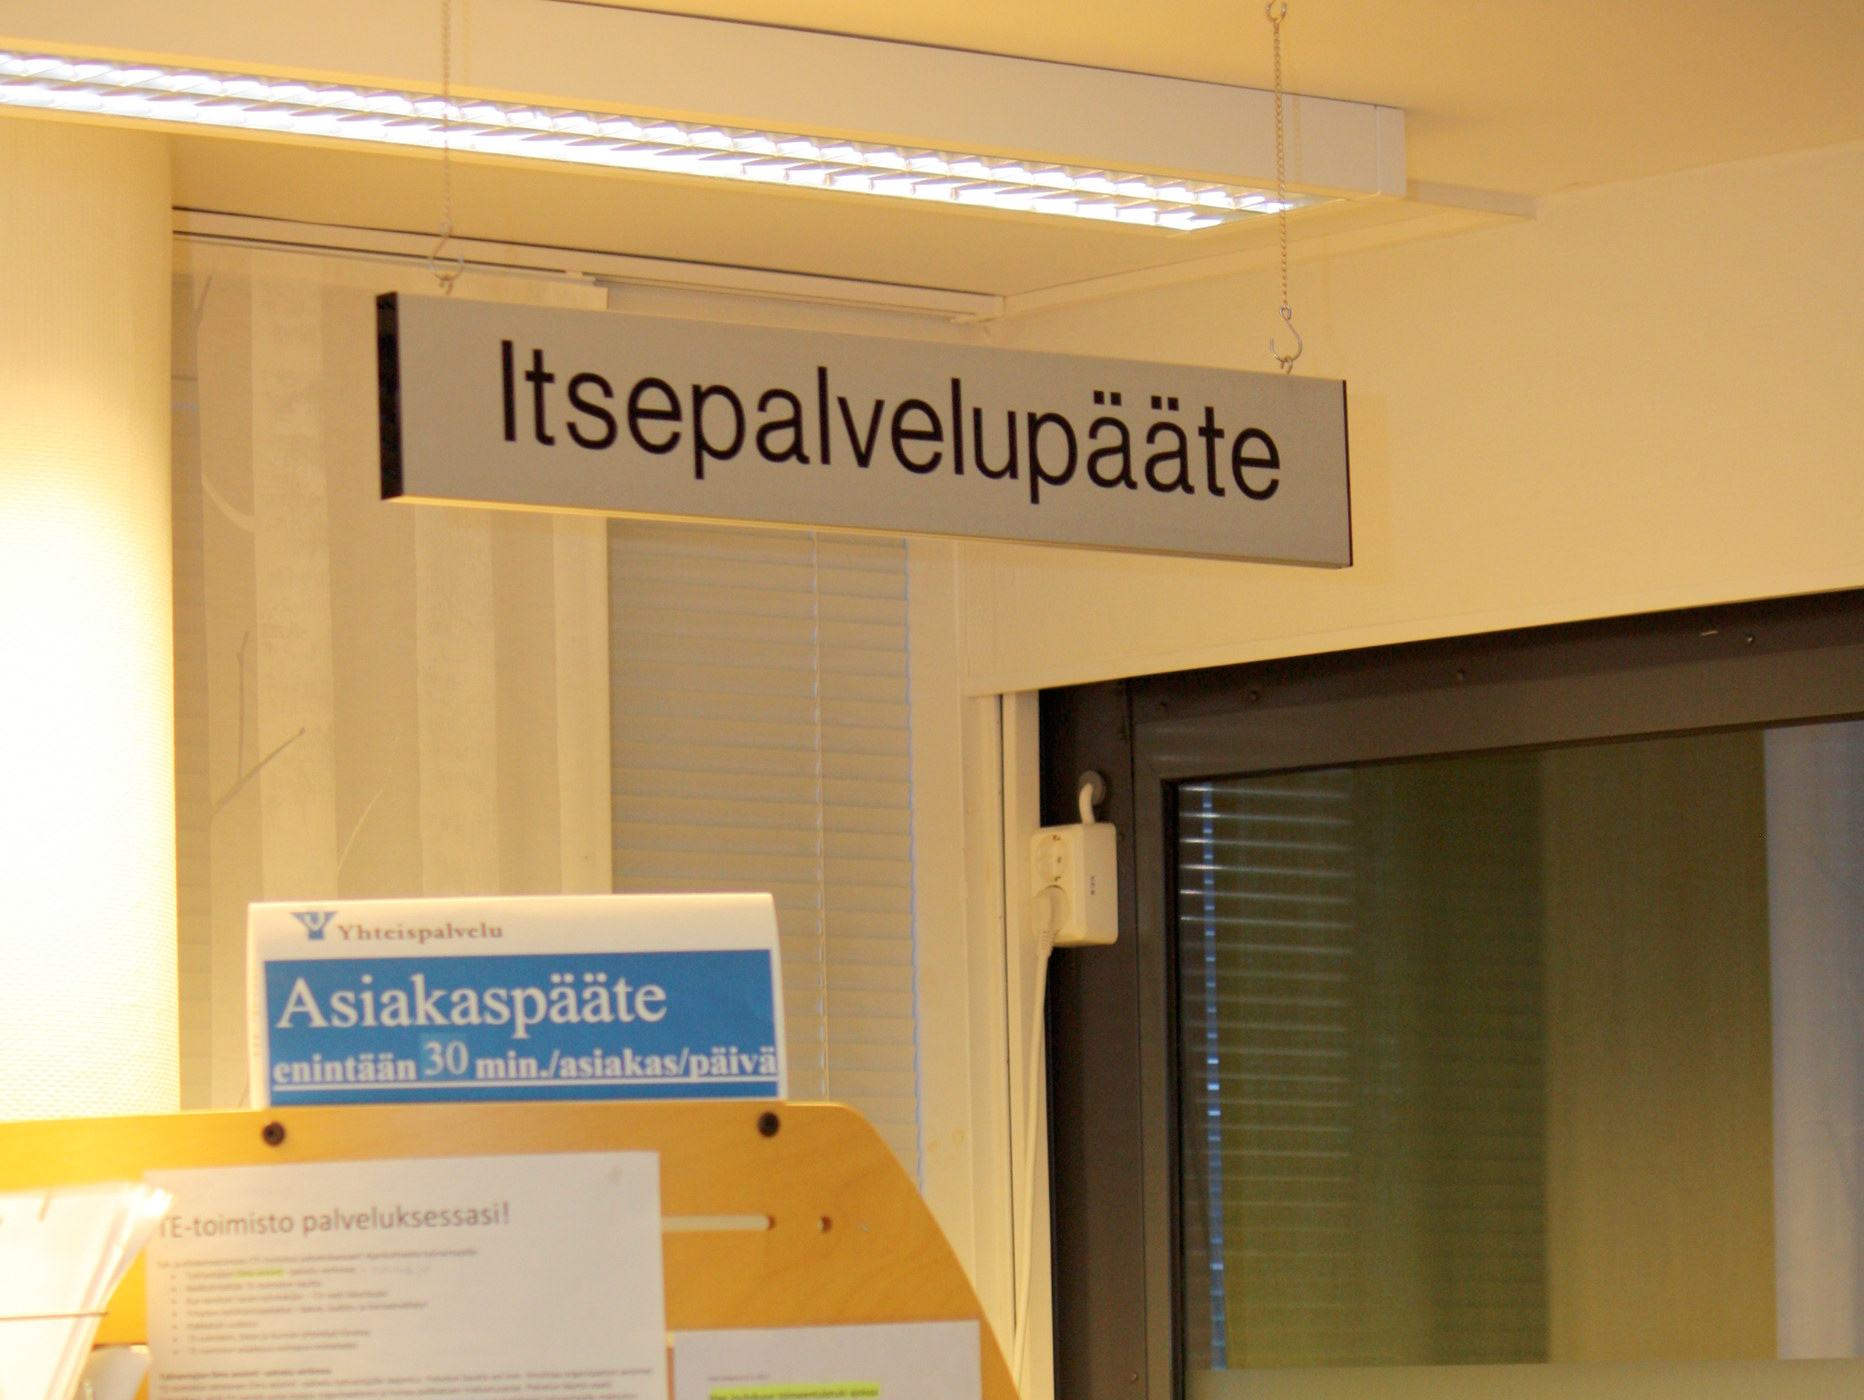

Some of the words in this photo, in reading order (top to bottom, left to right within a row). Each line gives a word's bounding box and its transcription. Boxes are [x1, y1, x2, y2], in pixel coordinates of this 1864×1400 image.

[501, 339, 1281, 505] Itsepalvelupääte
[337, 921, 504, 944] Yhteispalvelu
[275, 972, 668, 1039] Asiakaspääte
[272, 1053, 418, 1083] enintään
[424, 1040, 470, 1077] 30
[475, 1046, 778, 1083] min./asiakas/päivä
[159, 1210, 295, 1239] TE-toimisto
[302, 1200, 510, 1237] palveluksessasi!
